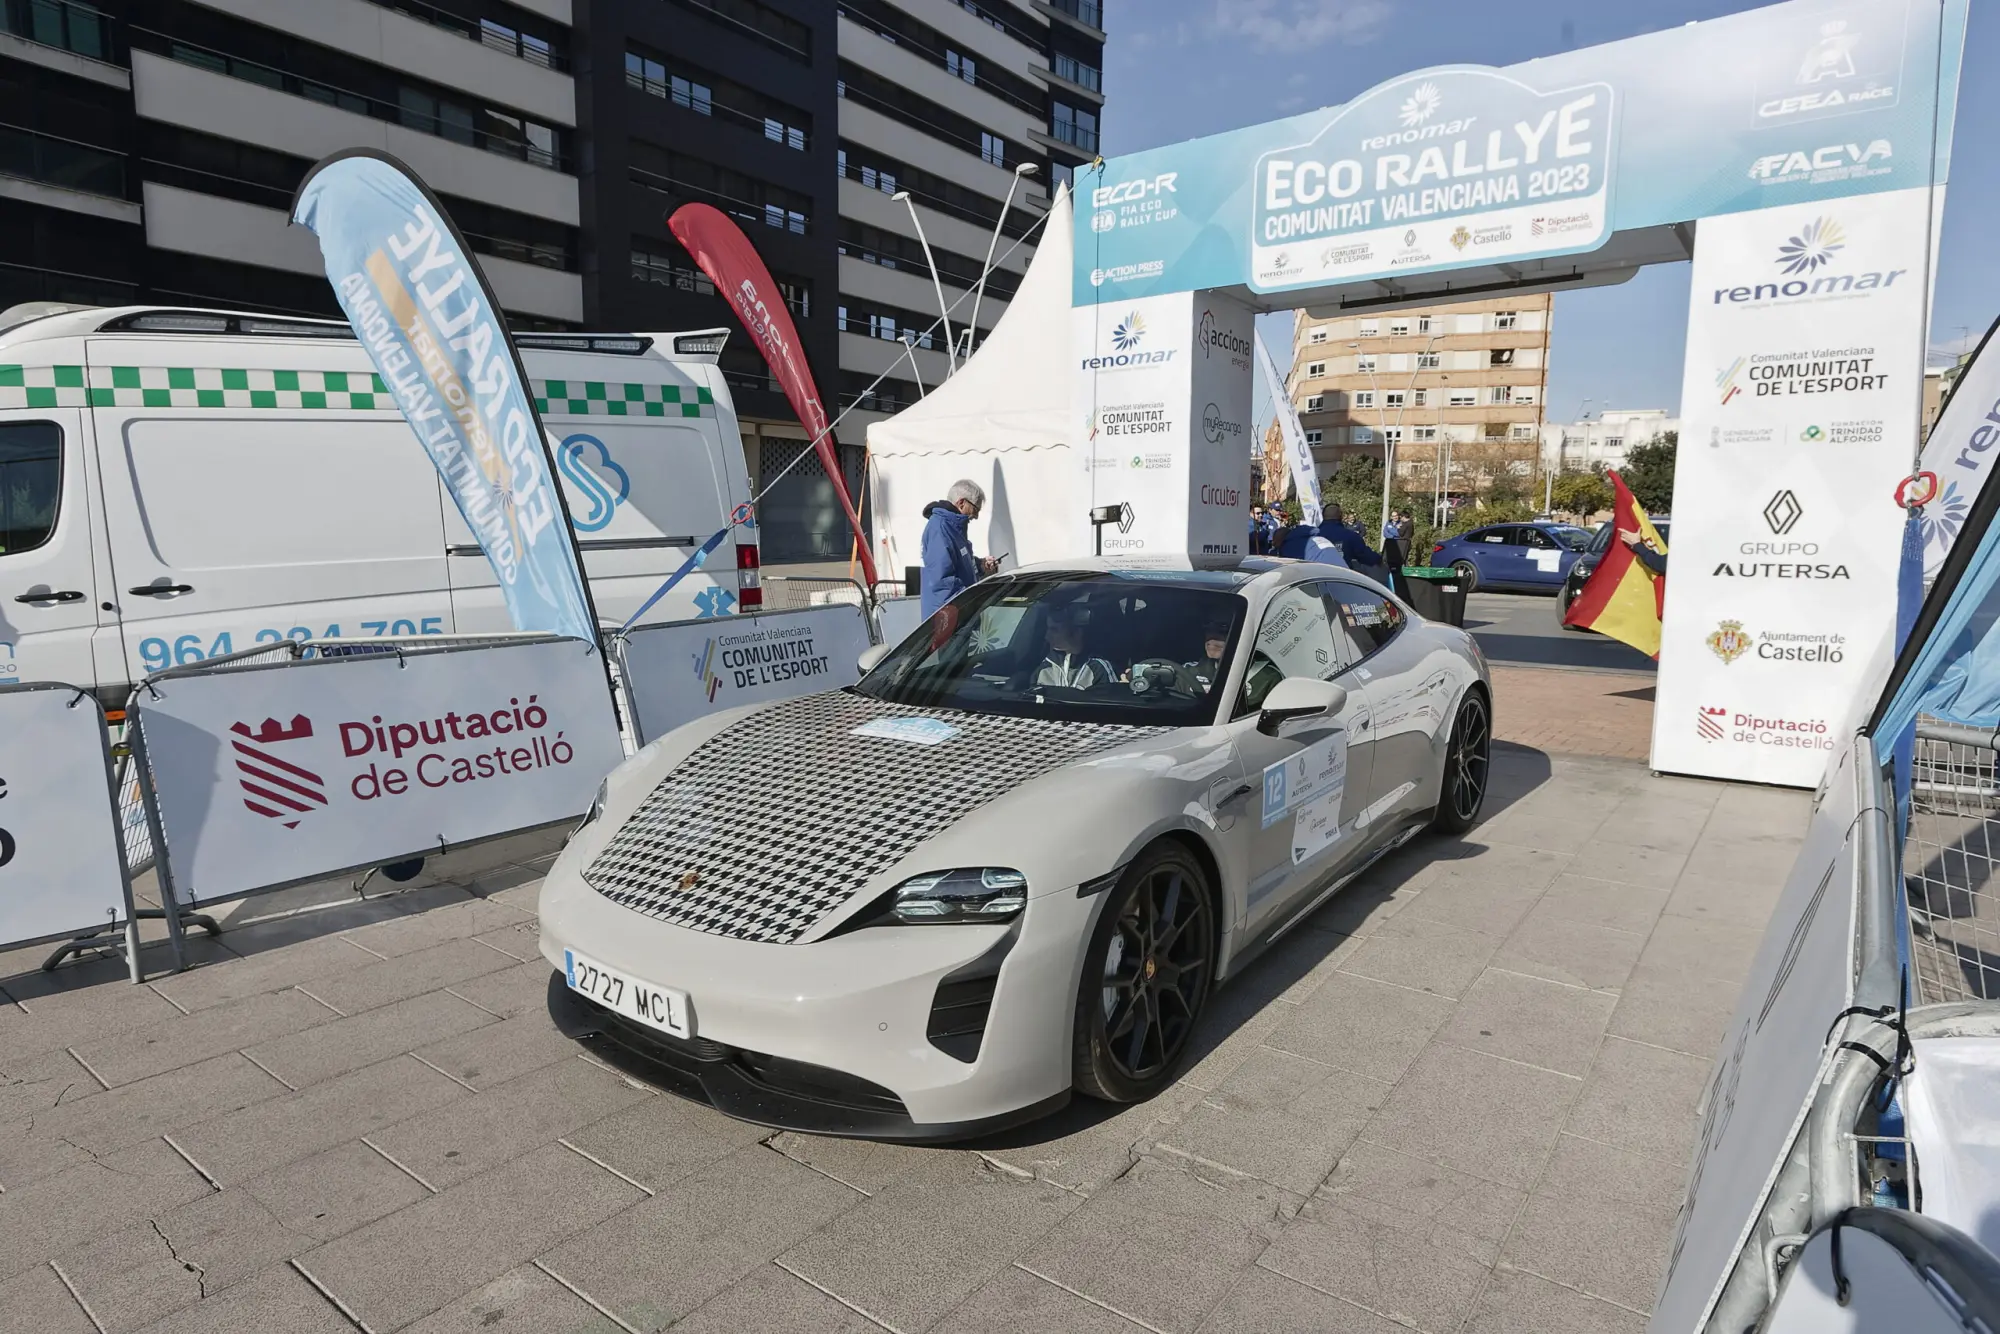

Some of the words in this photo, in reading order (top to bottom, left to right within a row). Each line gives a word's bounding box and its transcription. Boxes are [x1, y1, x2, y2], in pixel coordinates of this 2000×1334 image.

[1848, 86, 1893, 103] RACE
[1361, 115, 1478, 152] renomar
[1265, 159, 1362, 210] ECO
[1375, 93, 1596, 191] RALLYE
[1092, 172, 1178, 208] ECO-R
[1121, 205, 1137, 217] FIA
[1140, 199, 1162, 213] ECO
[1264, 199, 1375, 241] COMUNITAT
[1381, 174, 1520, 221] VALENCIANA
[1527, 164, 1590, 198] 2023
[1120, 213, 1152, 228] RALLY
[1155, 208, 1178, 222] CUP
[1548, 213, 1590, 226] Diputació
[1473, 230, 1512, 245] Castelló
[1330, 247, 1369, 259] COMUNITAT
[1333, 256, 1343, 265] DE
[1390, 254, 1431, 266] AUTERSA
[1105, 264, 1137, 278] ACTION
[1138, 260, 1164, 273] PRESS
[1260, 267, 1304, 279] renomar
[1714, 268, 1907, 305] renomar
[1211, 329, 1250, 357] acciona
[1082, 348, 1178, 370] renomar
[1750, 351, 1809, 363] Comunitat
[1812, 347, 1874, 359] Valenciana
[1749, 358, 1875, 381] COMUNITAT
[1756, 381, 1782, 396] DE
[1789, 374, 1888, 395] L'ESPORT
[1102, 403, 1132, 412] Comunitat
[1133, 402, 1164, 411] Valenciana
[1102, 410, 1164, 424] COMUNITAT
[1107, 425, 1120, 435] DE
[1123, 421, 1172, 434] L'ESPORT
[1204, 416, 1242, 436] myRecarga
[1830, 427, 1883, 435] TRINIDAD
[1830, 435, 1882, 443] ALFONSO
[1201, 484, 1240, 507] Circutor
[1104, 539, 1144, 549] GRUPO
[1740, 542, 1819, 555] GRUPO
[1712, 563, 1850, 580] AUTERSA
[719, 631, 766, 647] Comunitat
[767, 625, 812, 641] Valenciana
[1759, 631, 1827, 645] Ajuntament
[1830, 633, 1846, 644] de
[138, 632, 234, 673] 964
[722, 639, 815, 669] COMUNITAT
[1758, 642, 1843, 664] Castelló
[734, 668, 757, 689] DE
[760, 656, 829, 684] L'ESPORT
[338, 694, 548, 759] Diputació
[1734, 714, 1827, 734] Diputació
[1733, 730, 1757, 744] de
[1760, 732, 1835, 751] Castelló
[351, 763, 408, 800] de
[416, 731, 574, 788] Castelló
[1267, 772, 1283, 806] 12
[578, 962, 624, 1006] 2727
[635, 985, 681, 1031] MCL
